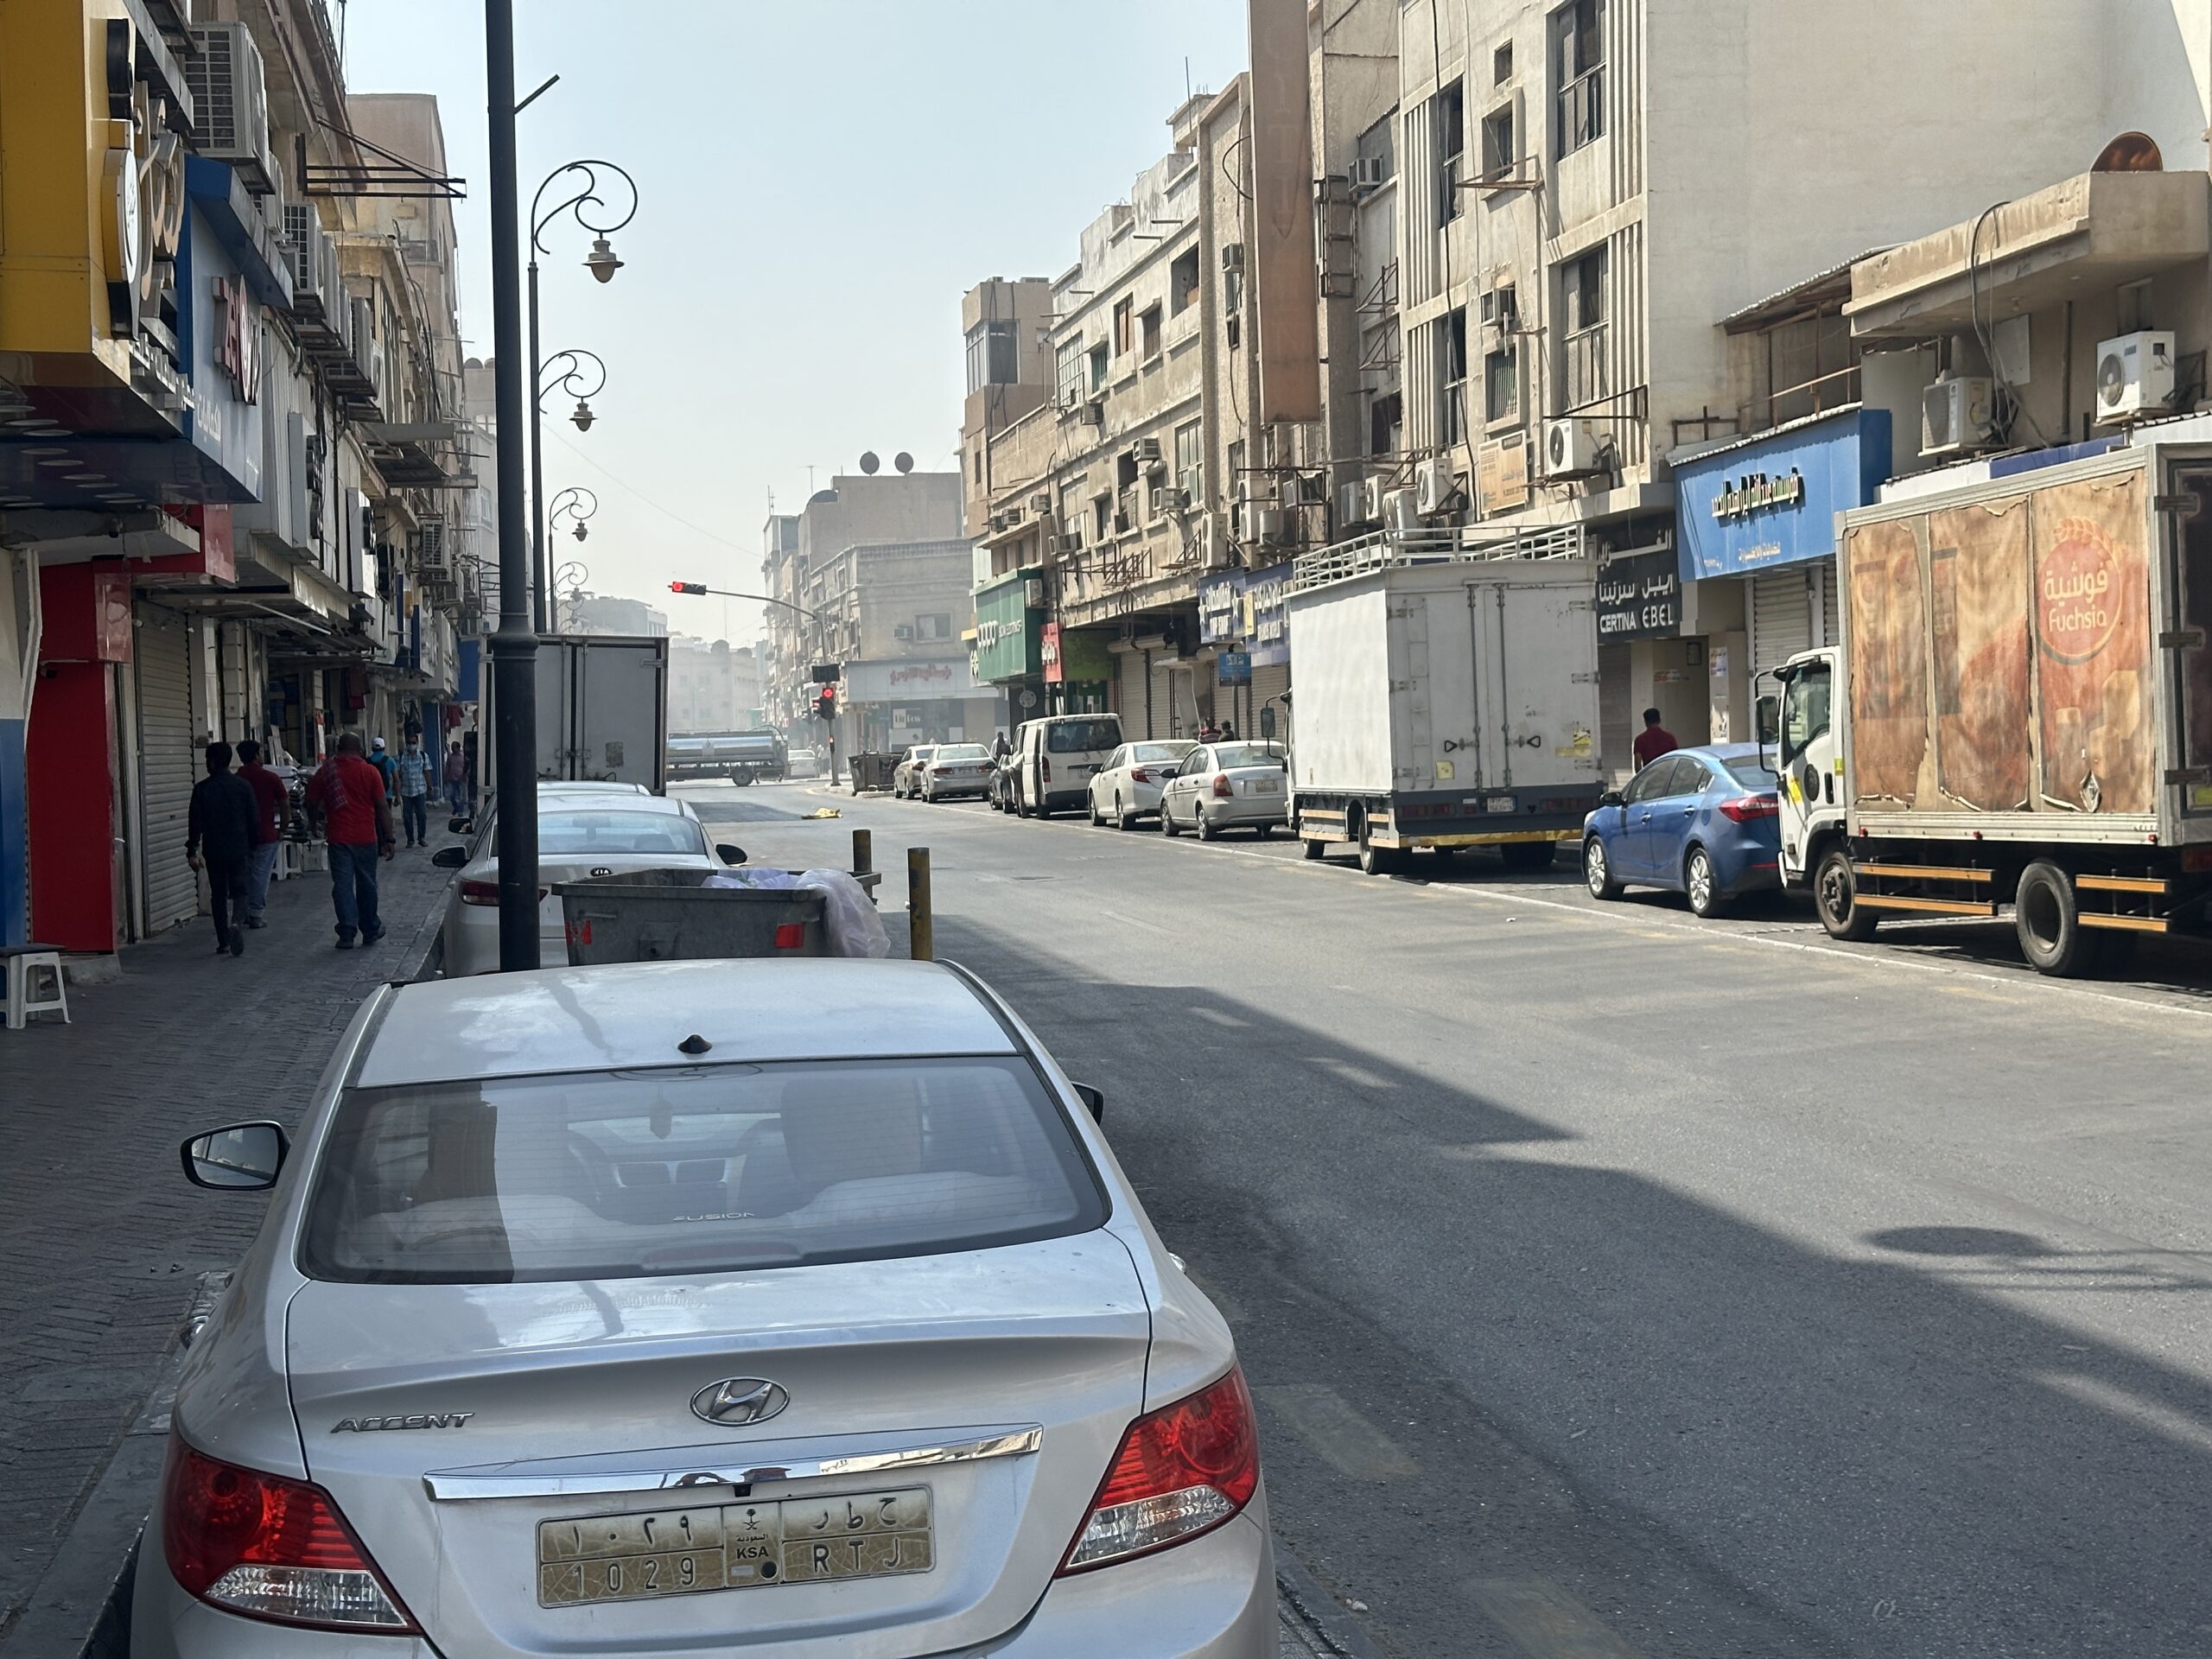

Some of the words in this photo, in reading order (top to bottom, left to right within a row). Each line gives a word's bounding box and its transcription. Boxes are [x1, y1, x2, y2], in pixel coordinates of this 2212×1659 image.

[1599, 580, 1635, 606] سرتينا
[2044, 561, 2108, 607] فوشية
[1599, 611, 1637, 633] CERTINA
[1642, 603, 1674, 629] EBEL
[330, 1412, 475, 1433] ACCENT
[735, 1533, 769, 1543] السعودية
[736, 1546, 769, 1560] KSA
